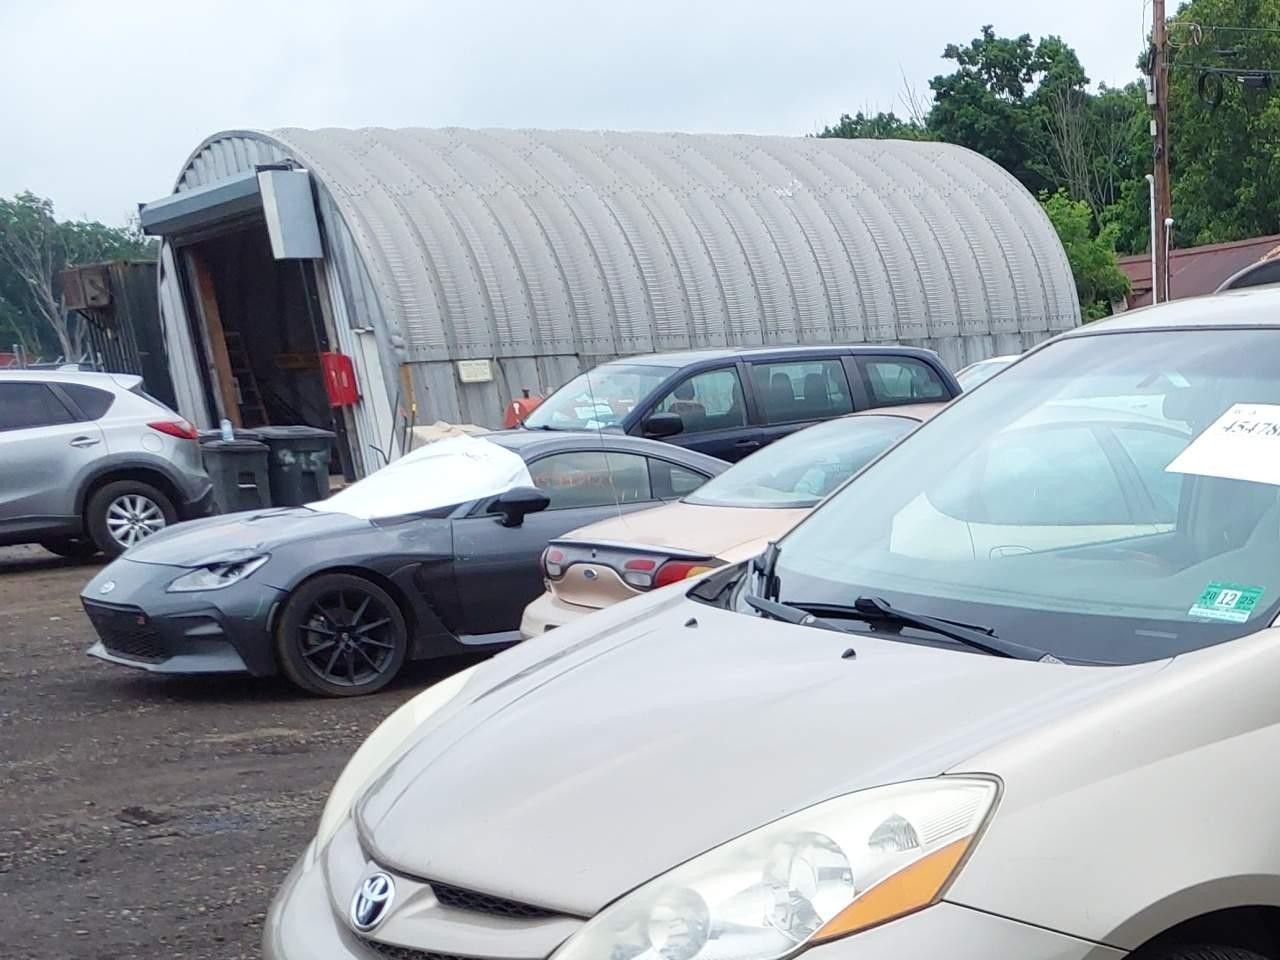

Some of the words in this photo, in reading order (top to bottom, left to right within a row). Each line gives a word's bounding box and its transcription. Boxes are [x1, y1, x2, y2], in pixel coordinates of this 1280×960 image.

[1203, 591, 1217, 600] 20
[1217, 592, 1238, 606] 12
[1239, 596, 1257, 605] 25
